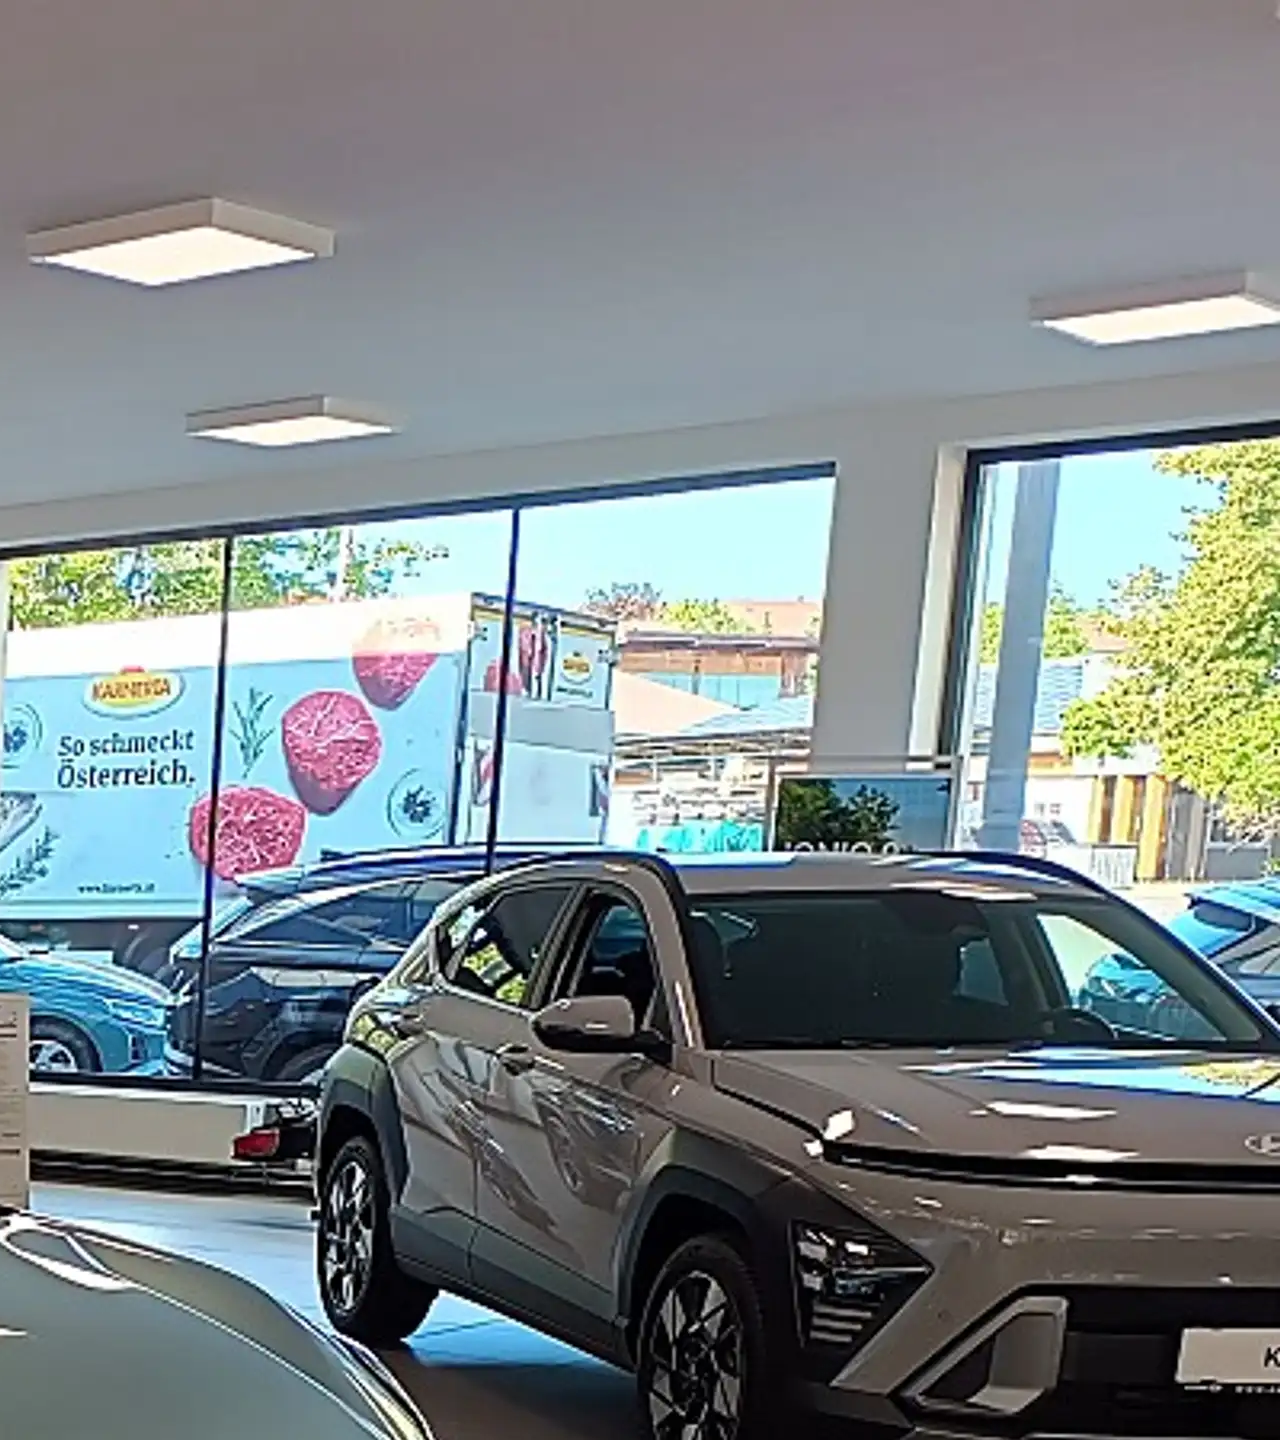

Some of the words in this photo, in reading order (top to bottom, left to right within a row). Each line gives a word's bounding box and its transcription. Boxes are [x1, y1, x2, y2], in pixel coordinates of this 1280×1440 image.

[58, 735, 85, 757] So
[90, 729, 194, 757] schmeckt
[57, 757, 196, 788] Österreich.
